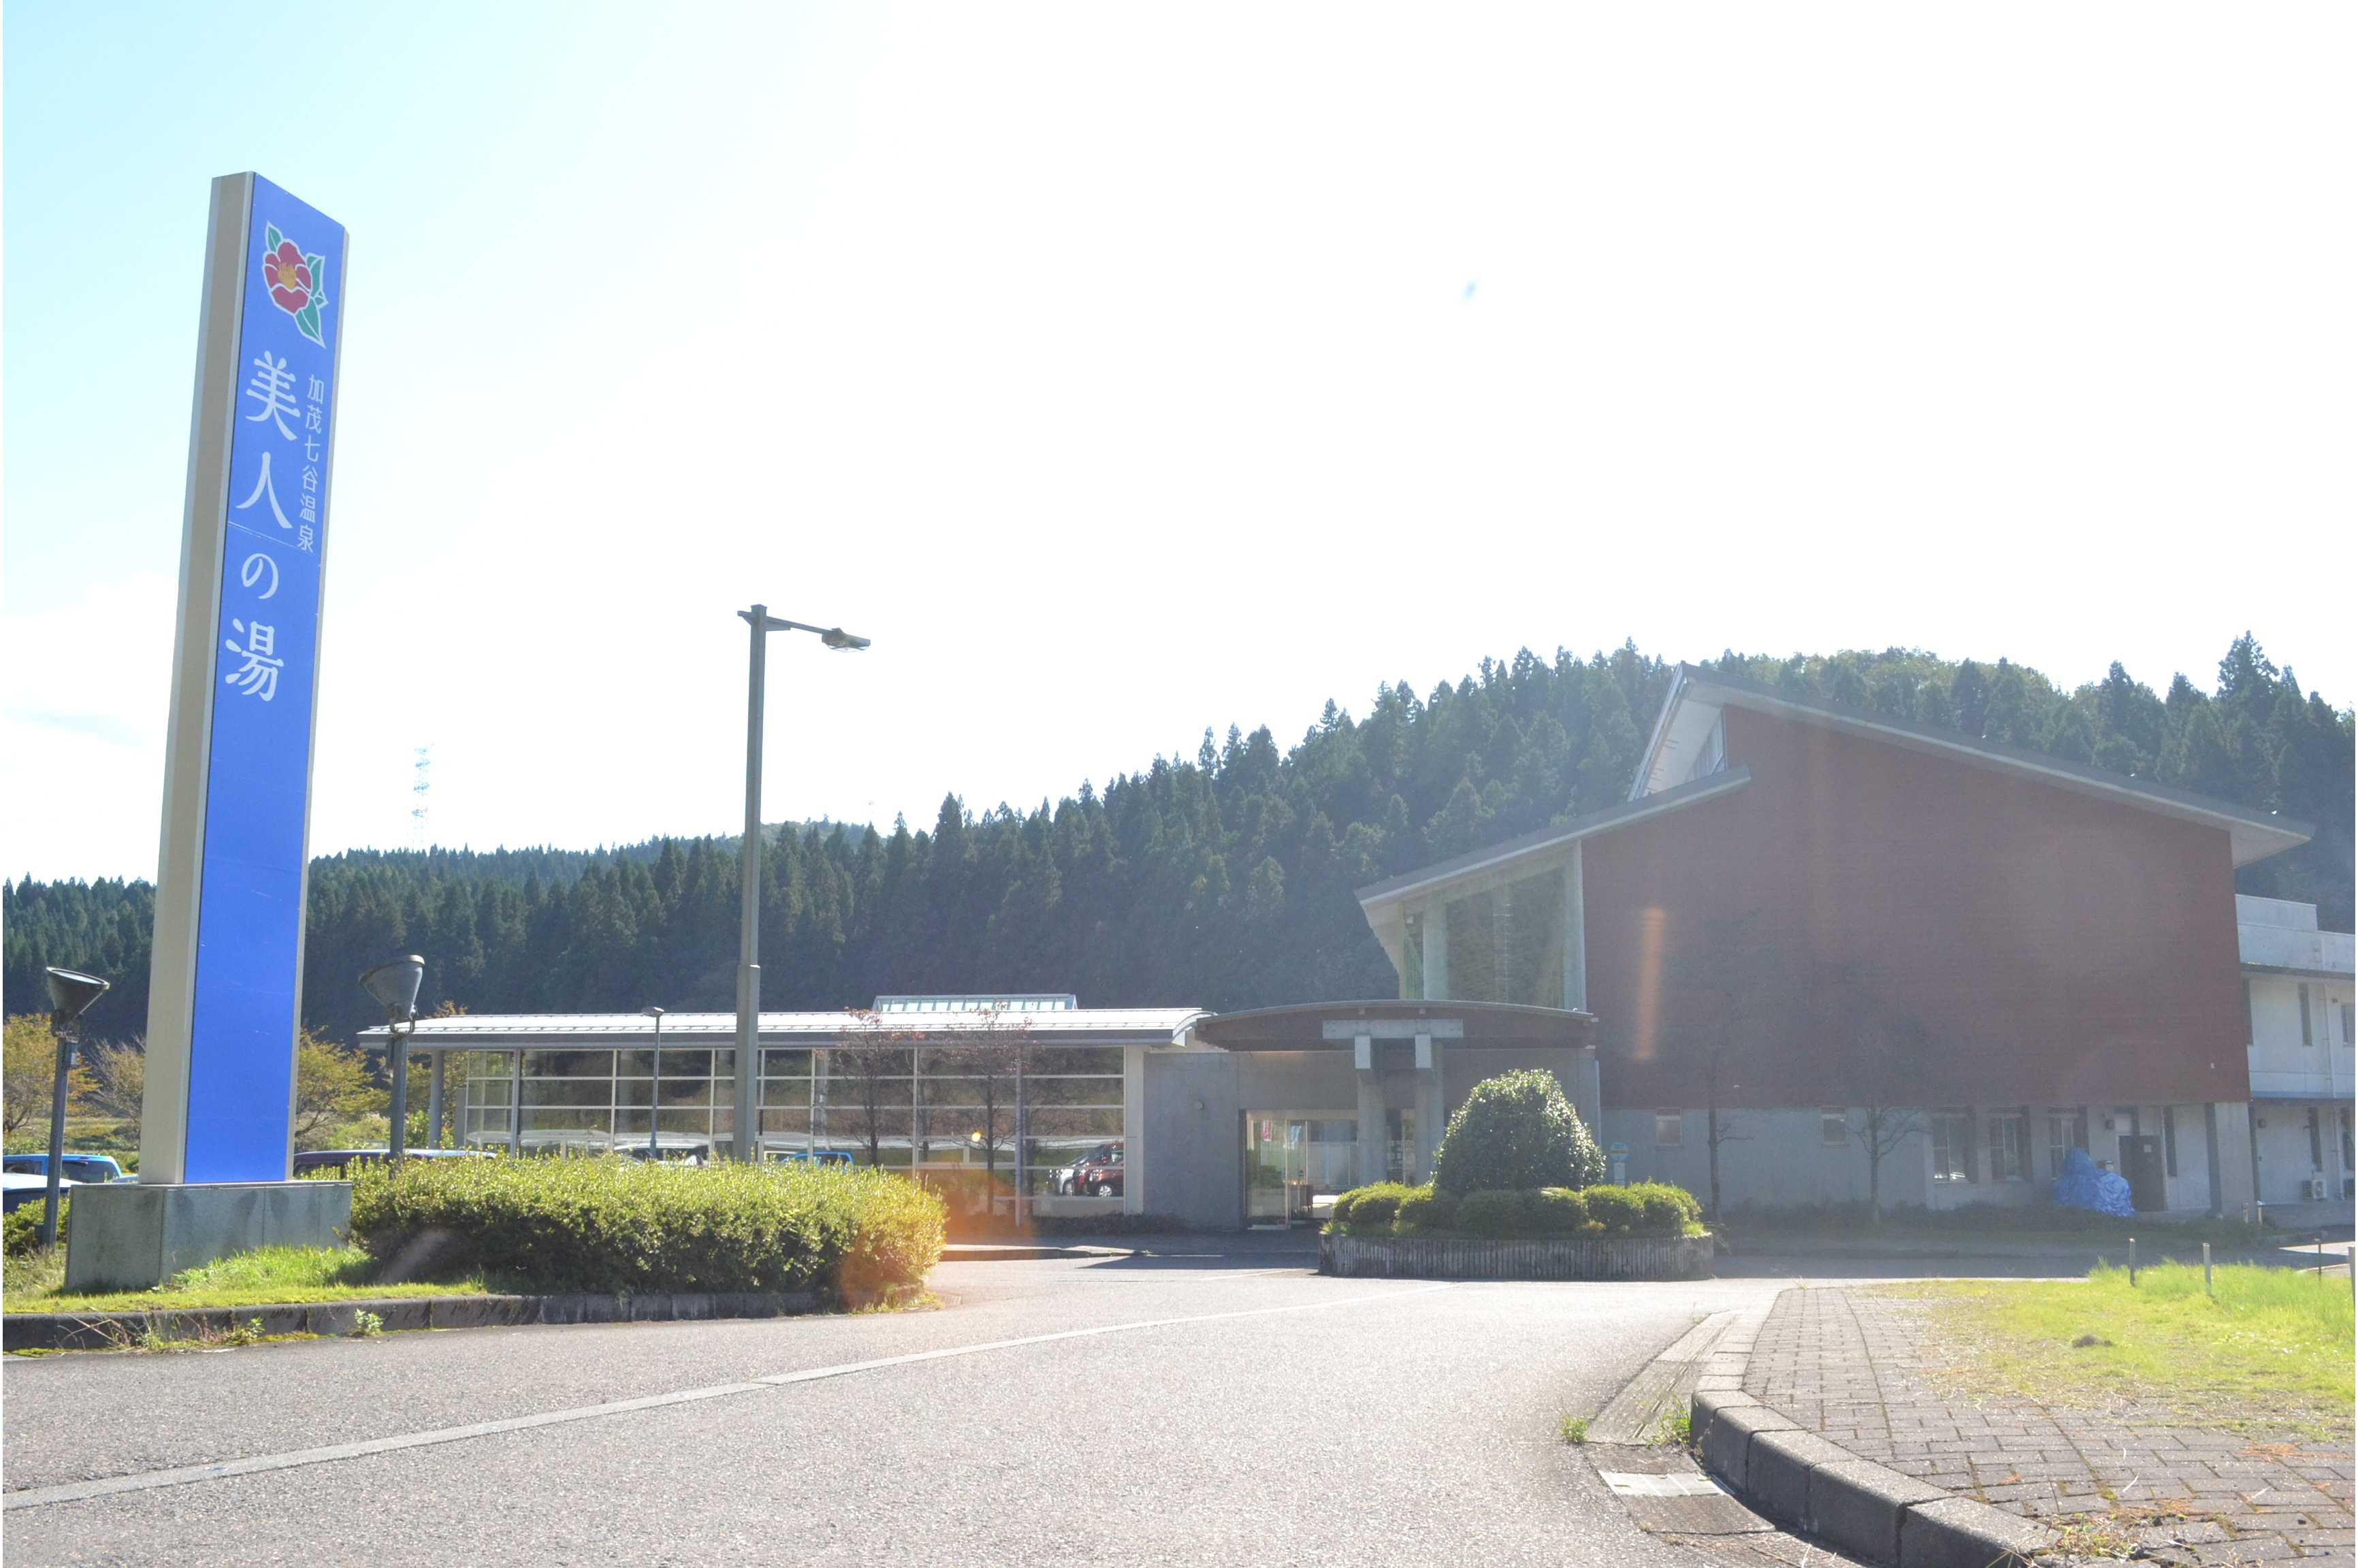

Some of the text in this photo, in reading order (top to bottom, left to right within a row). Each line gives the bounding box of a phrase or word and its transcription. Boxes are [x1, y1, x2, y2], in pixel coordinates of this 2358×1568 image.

[225, 350, 300, 702] 美人の湯
[297, 374, 324, 553] 加茂七谷温泉
